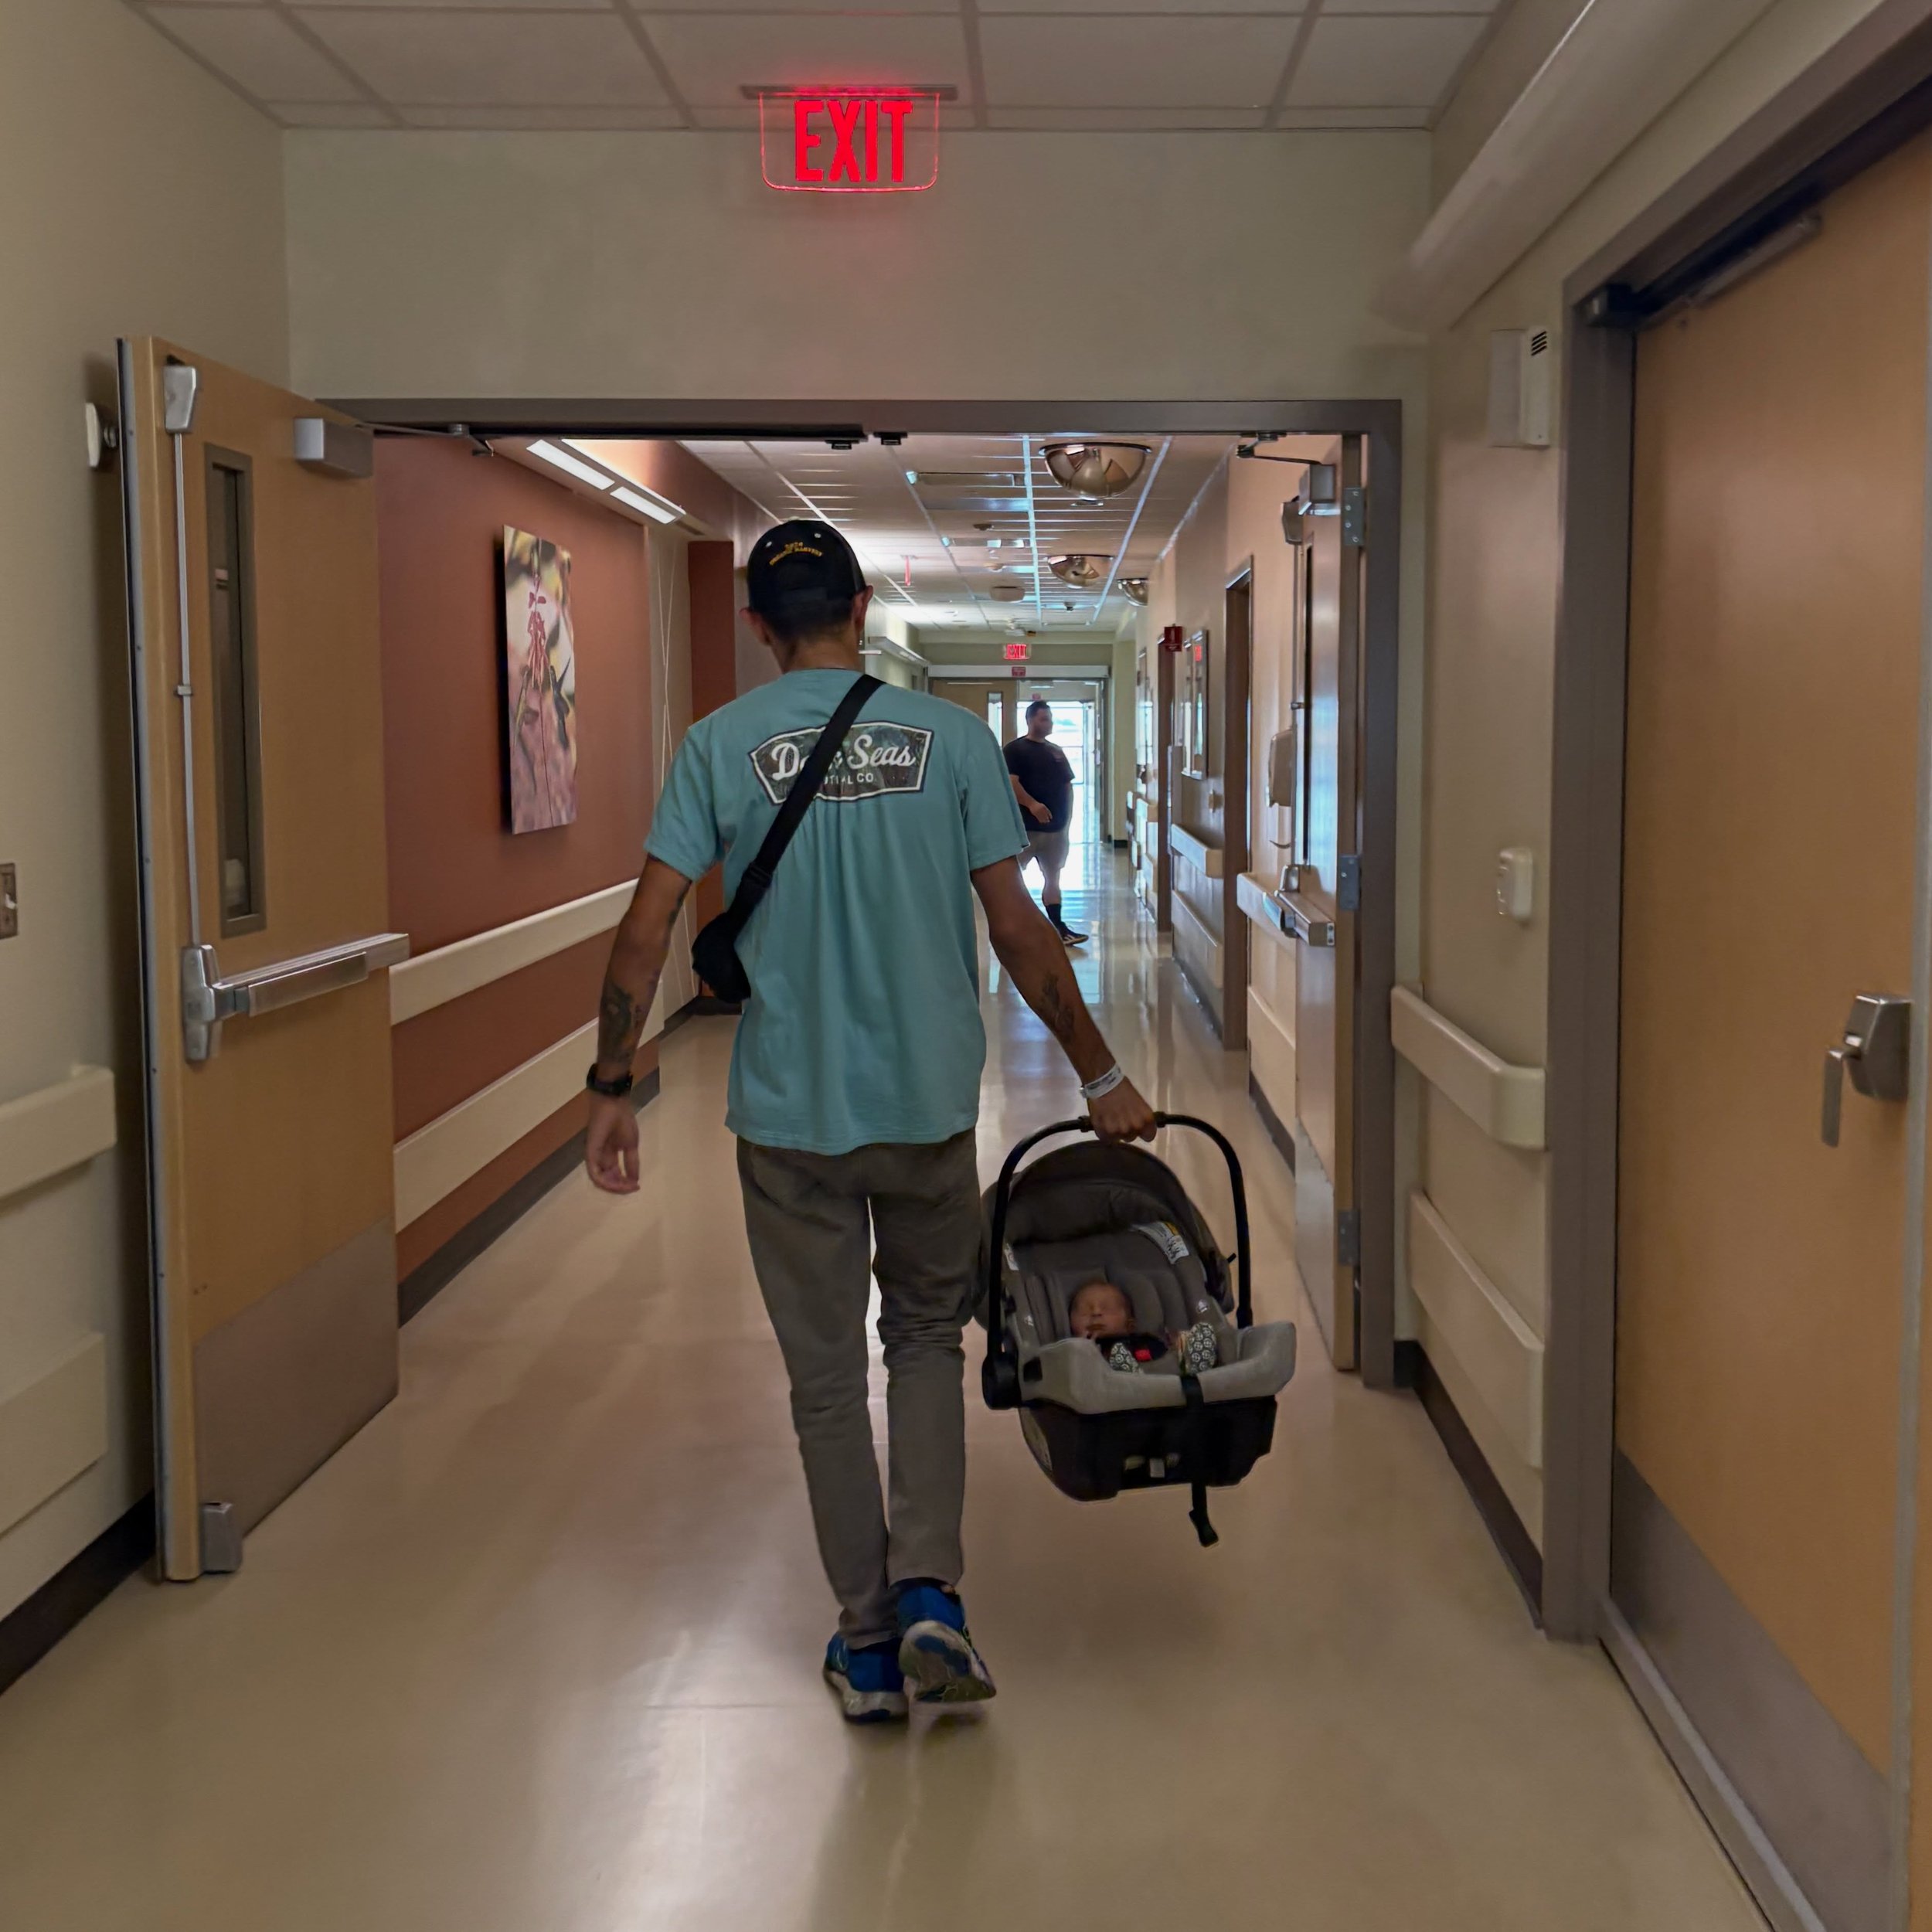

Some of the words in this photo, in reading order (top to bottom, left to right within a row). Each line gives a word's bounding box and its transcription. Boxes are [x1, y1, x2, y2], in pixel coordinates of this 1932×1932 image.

[794, 100, 913, 182] EXIT
[1006, 644, 1027, 659] EXIT
[847, 733, 916, 770] Seas
